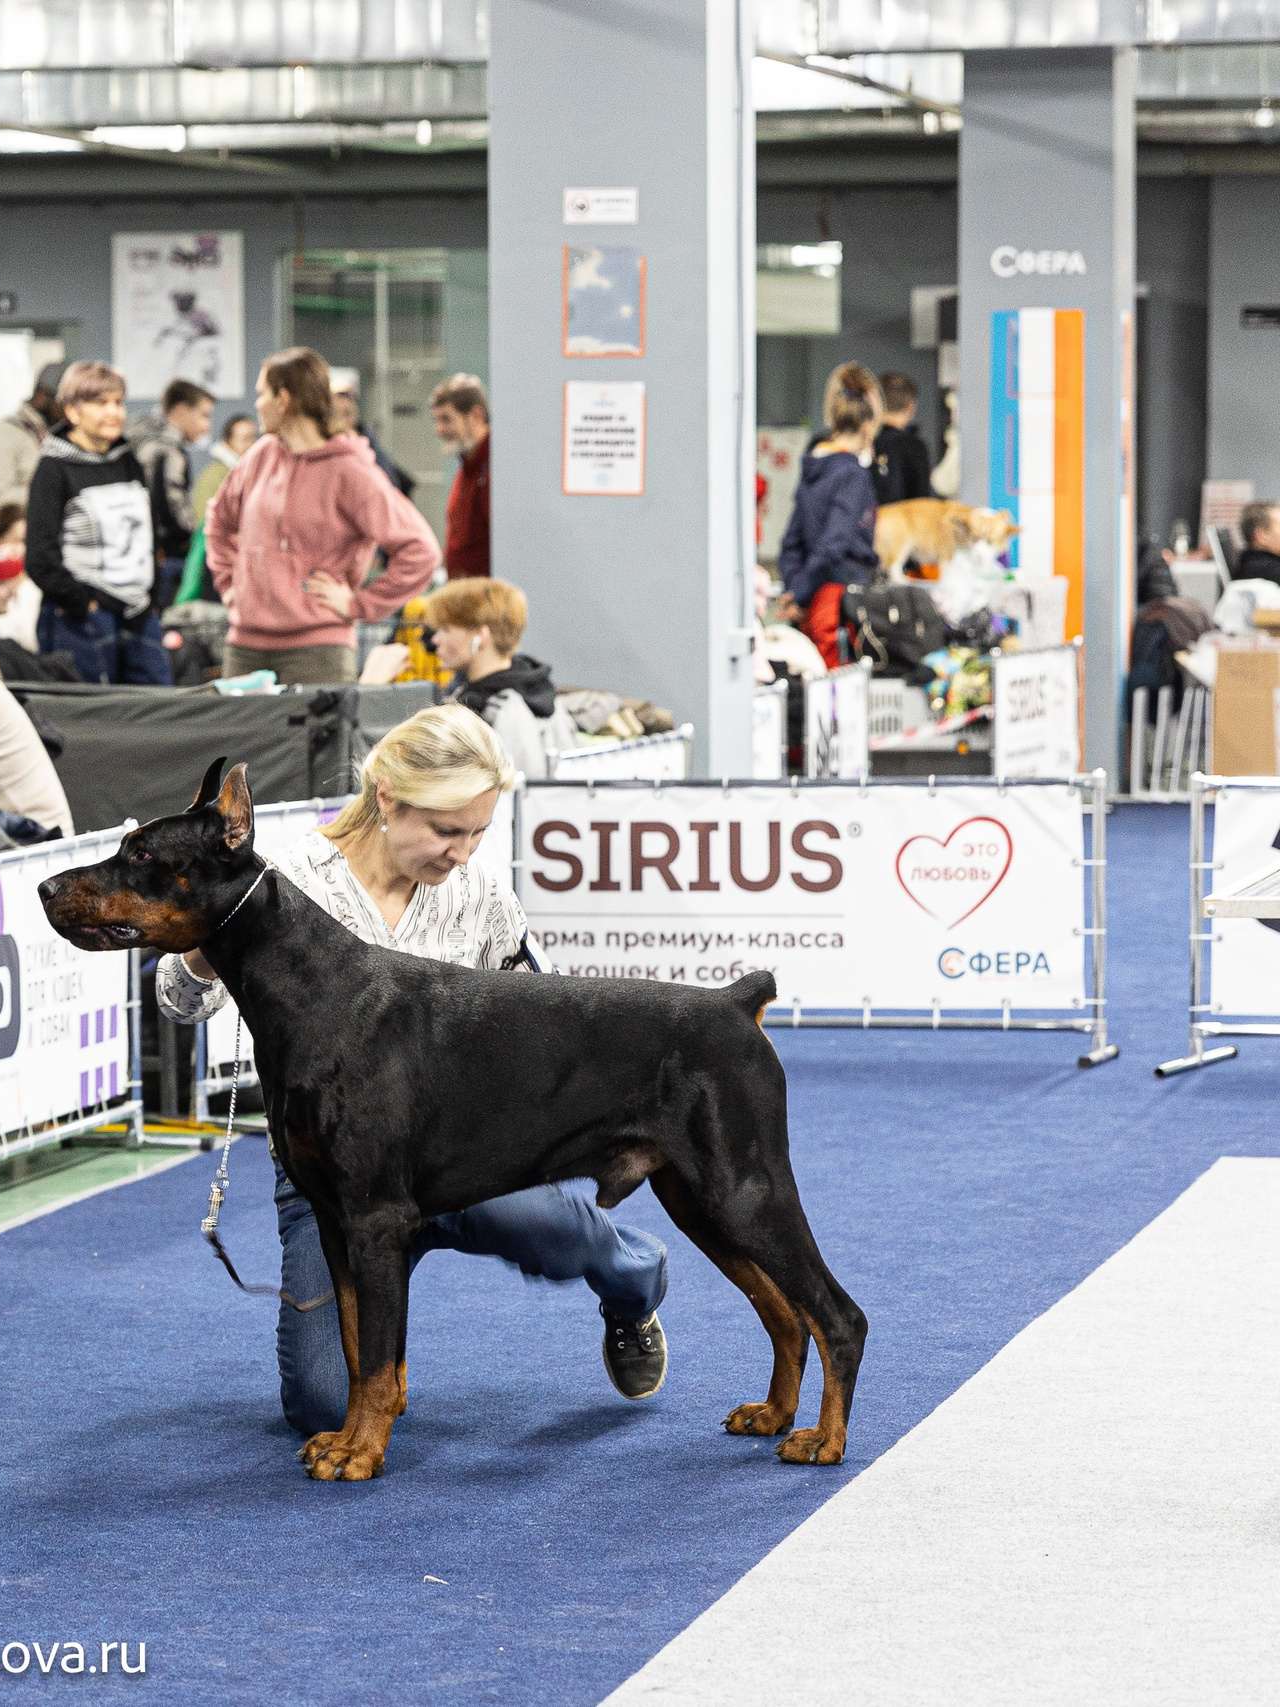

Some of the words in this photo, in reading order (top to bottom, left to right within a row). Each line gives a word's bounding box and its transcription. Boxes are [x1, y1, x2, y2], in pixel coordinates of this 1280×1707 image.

[963, 843, 999, 857] ЭТО
[911, 867, 992, 882] ЛЮБОВЬ
[605, 931, 844, 954] премиум-класса
[937, 947, 1051, 979] СФЕРА
[670, 966, 685, 980] и
